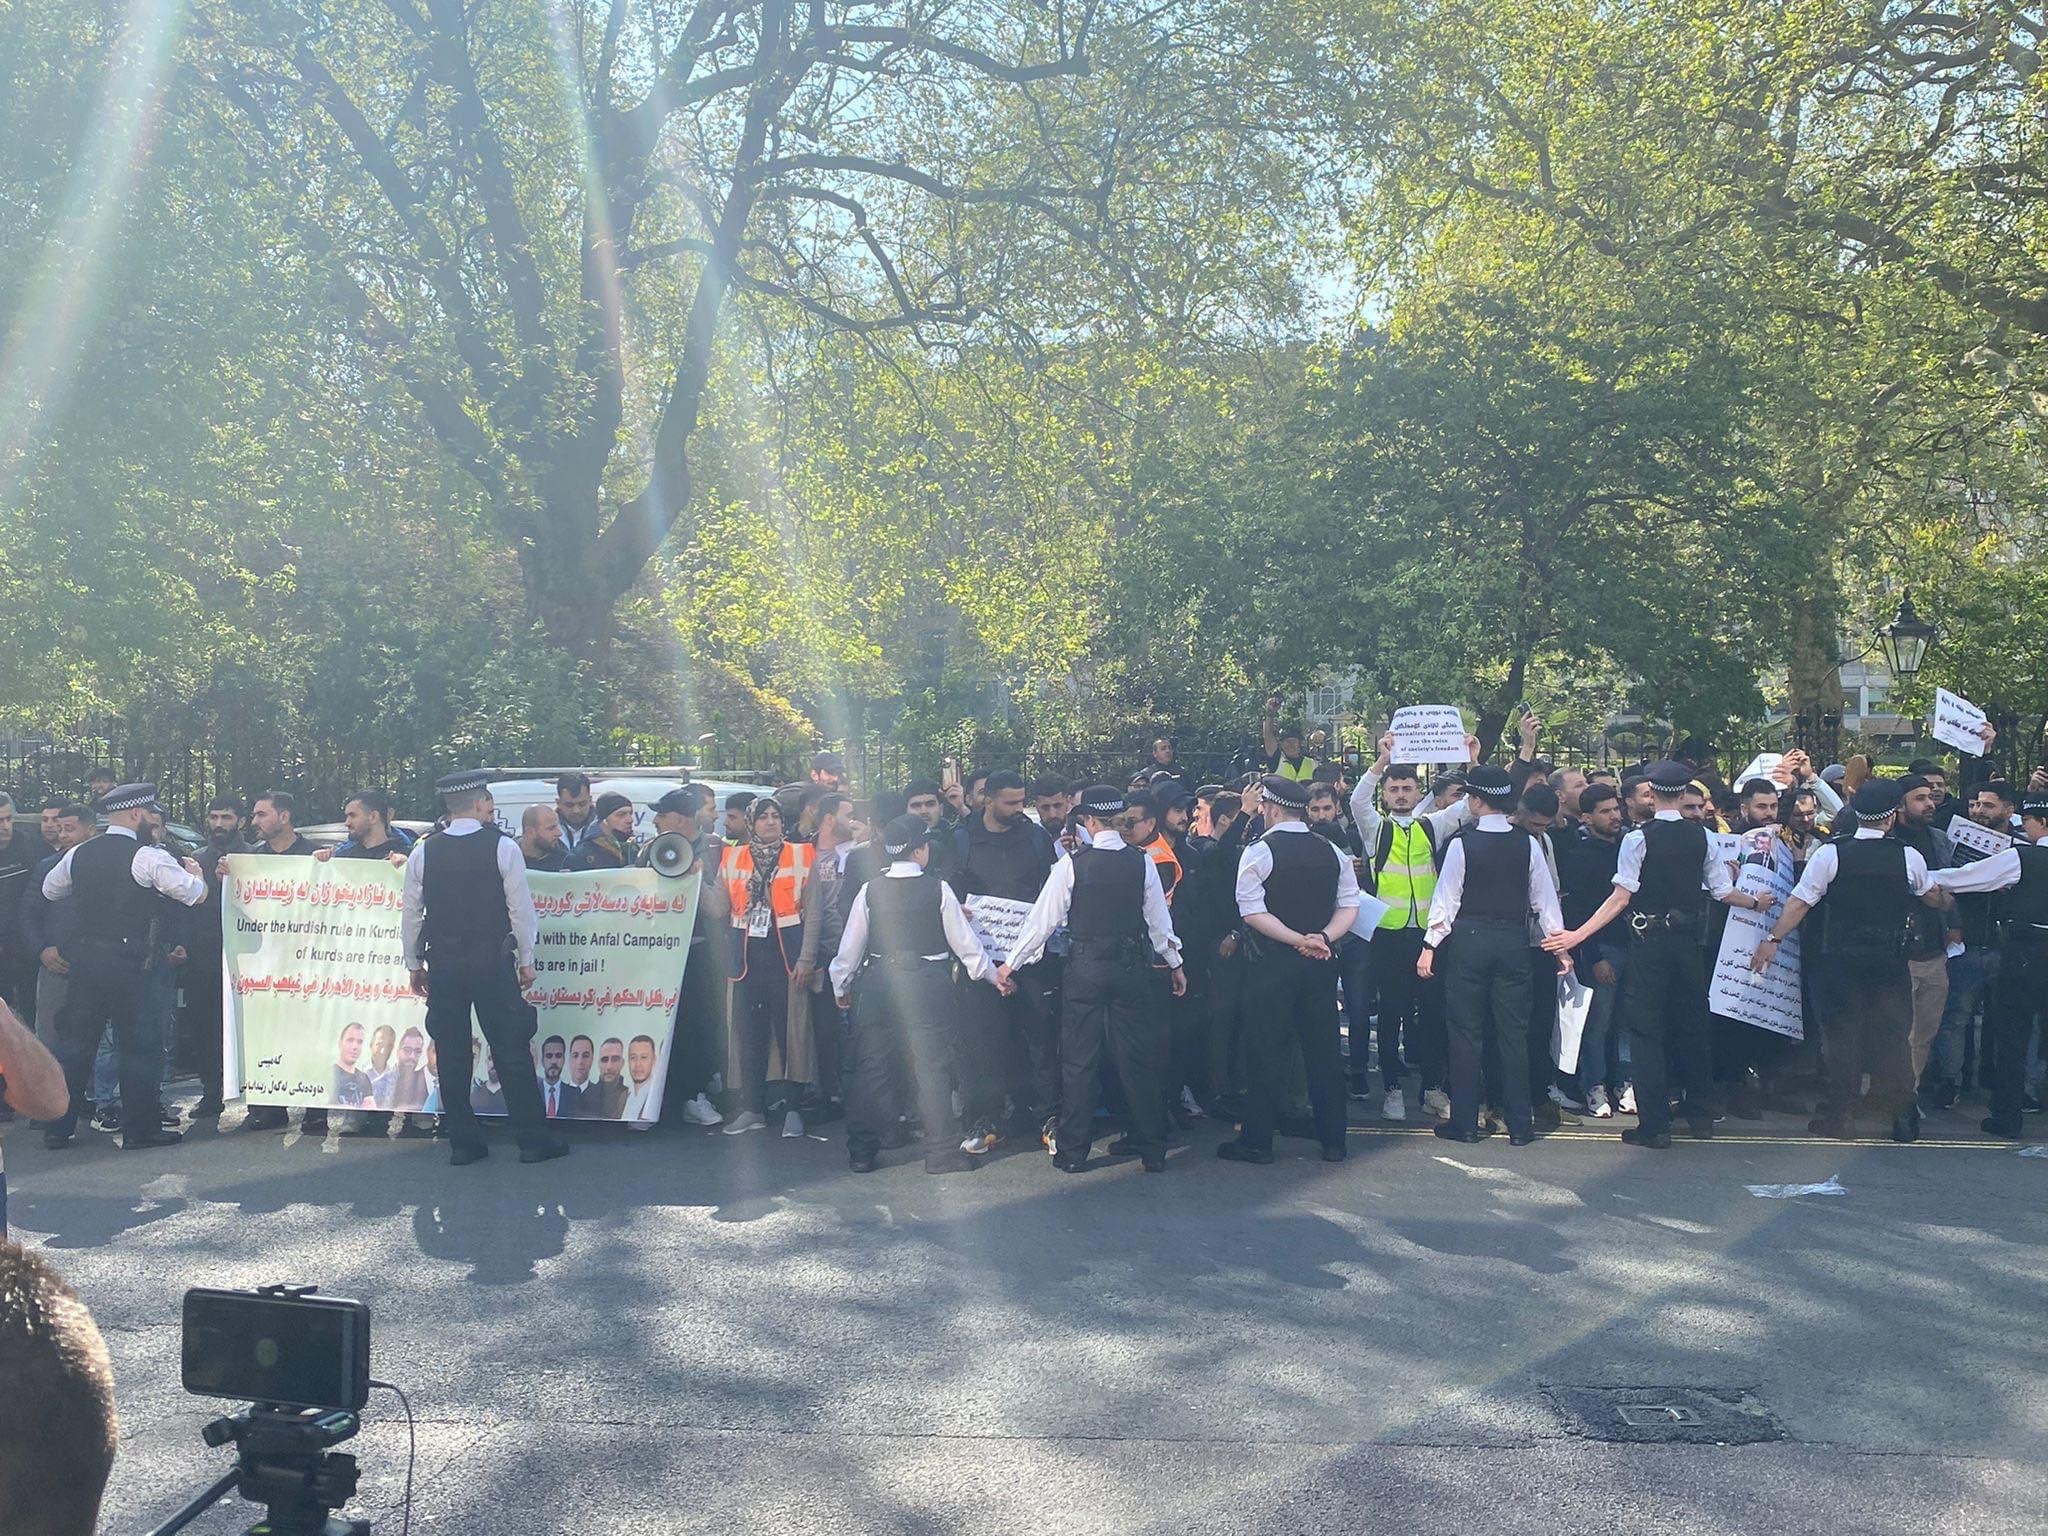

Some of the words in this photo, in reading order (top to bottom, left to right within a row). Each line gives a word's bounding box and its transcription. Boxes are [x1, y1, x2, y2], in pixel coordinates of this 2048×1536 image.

[237, 919, 268, 933] Under
[271, 919, 285, 933] the
[287, 920, 327, 935] kurdish
[331, 923, 352, 937] rule
[356, 924, 366, 937] in
[369, 924, 402, 939] Kurdi
[543, 932, 567, 946] with
[570, 932, 587, 946] the
[590, 932, 620, 946] Anfal
[623, 932, 680, 949] Campaign
[296, 946, 306, 960] of
[311, 948, 343, 962] kurds
[346, 951, 365, 964] are
[368, 949, 391, 965] free
[547, 961, 565, 972] are
[568, 959, 578, 972] in
[579, 959, 598, 975] jail
[601, 959, 605, 972] !
